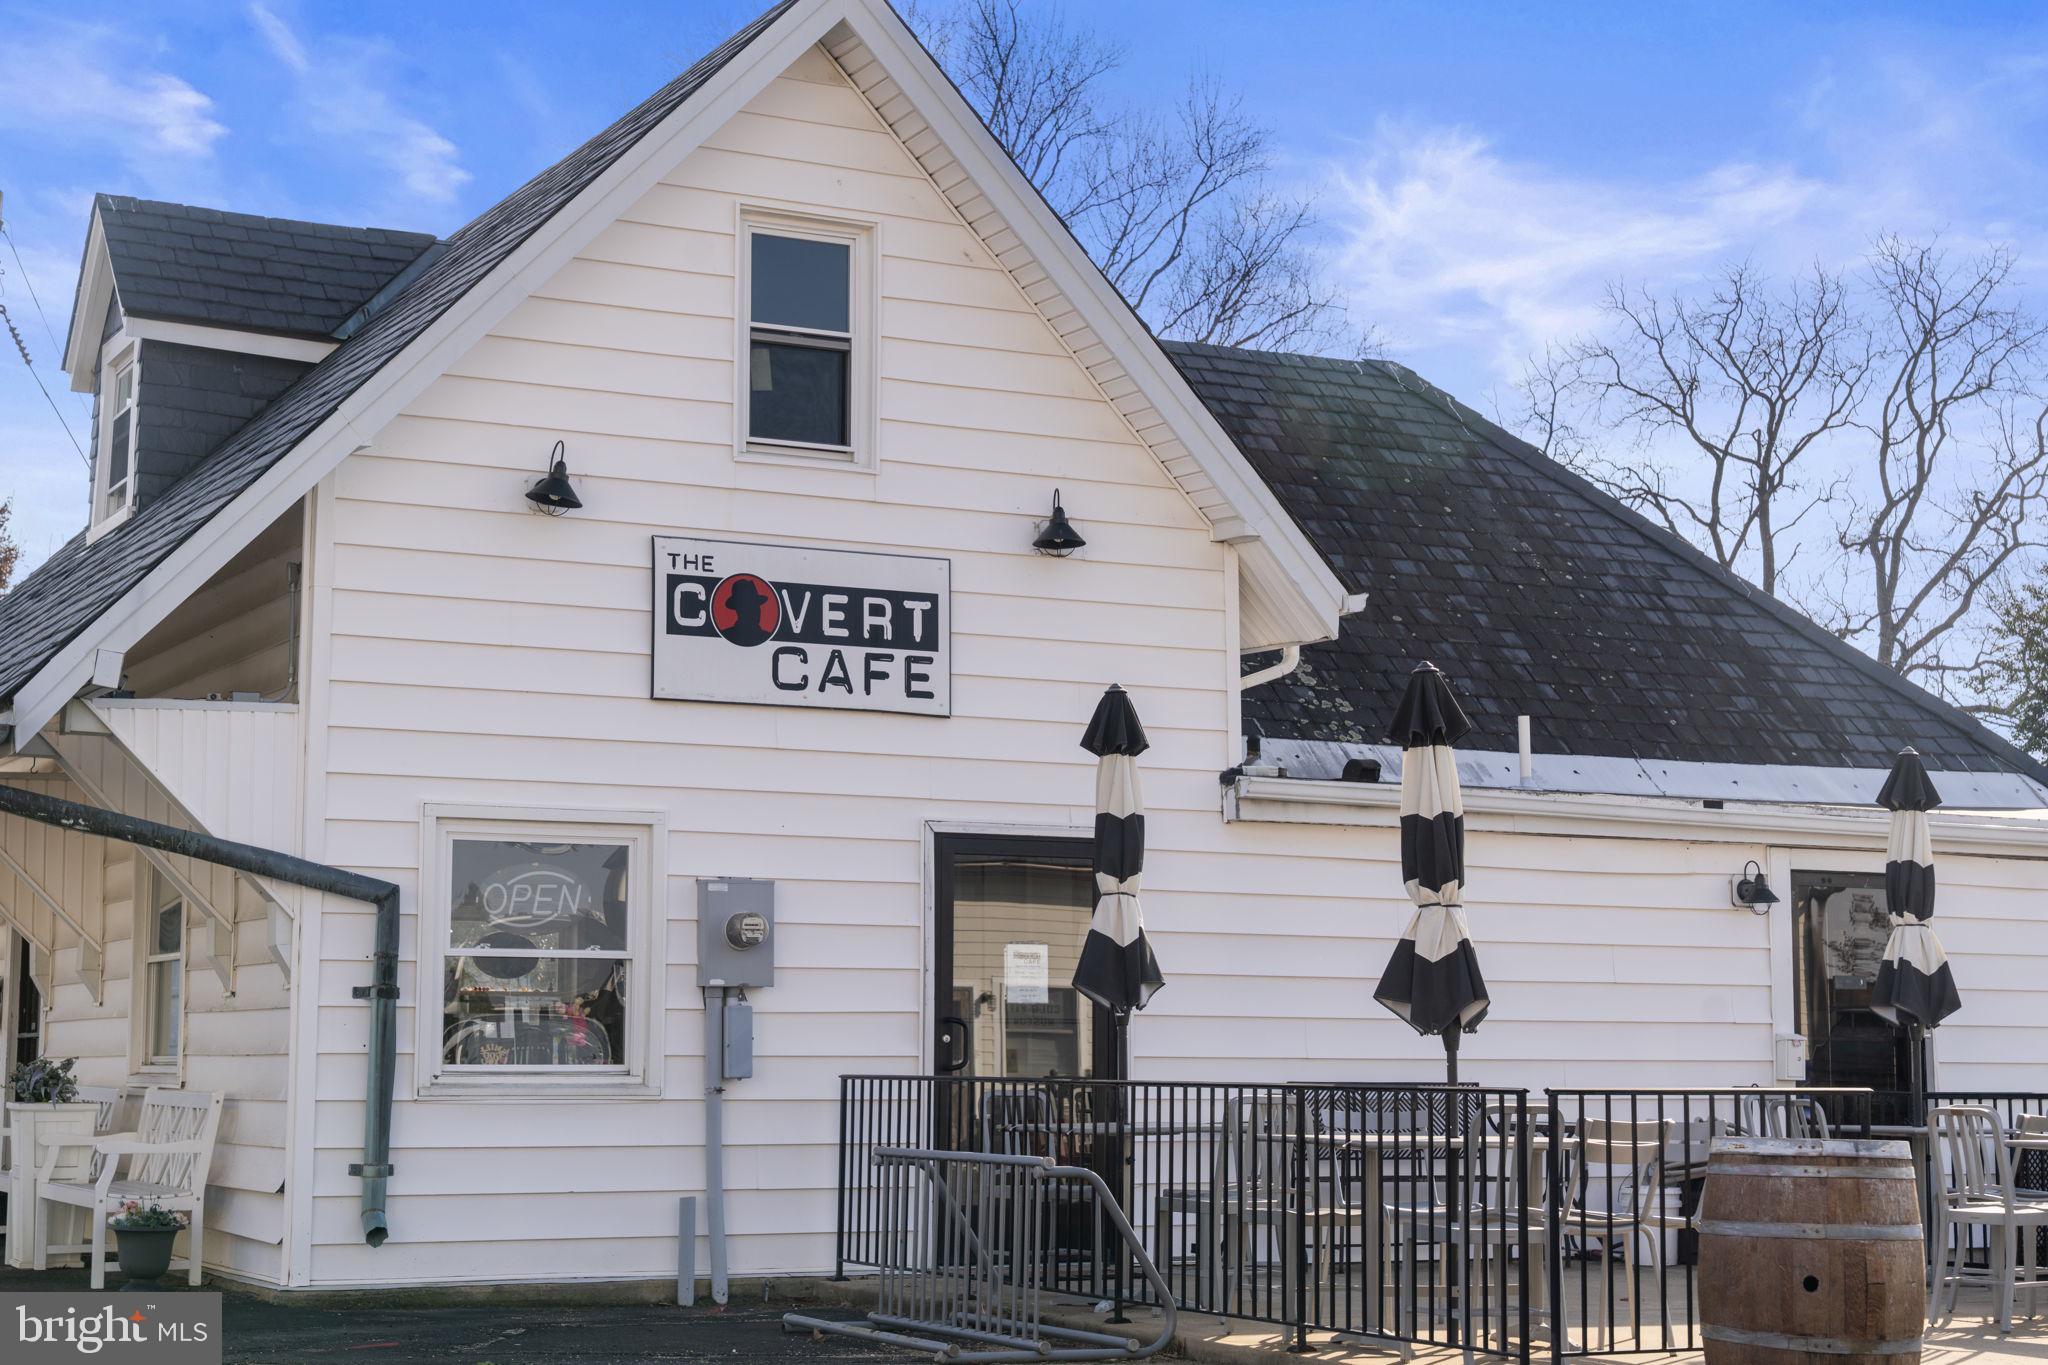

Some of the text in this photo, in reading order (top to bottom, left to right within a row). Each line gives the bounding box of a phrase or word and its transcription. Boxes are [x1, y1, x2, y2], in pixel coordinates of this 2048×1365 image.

[667, 552, 715, 573] THE
[673, 573, 932, 648] COVERT
[771, 646, 935, 699] CAFE
[483, 883, 582, 915] OPEN
